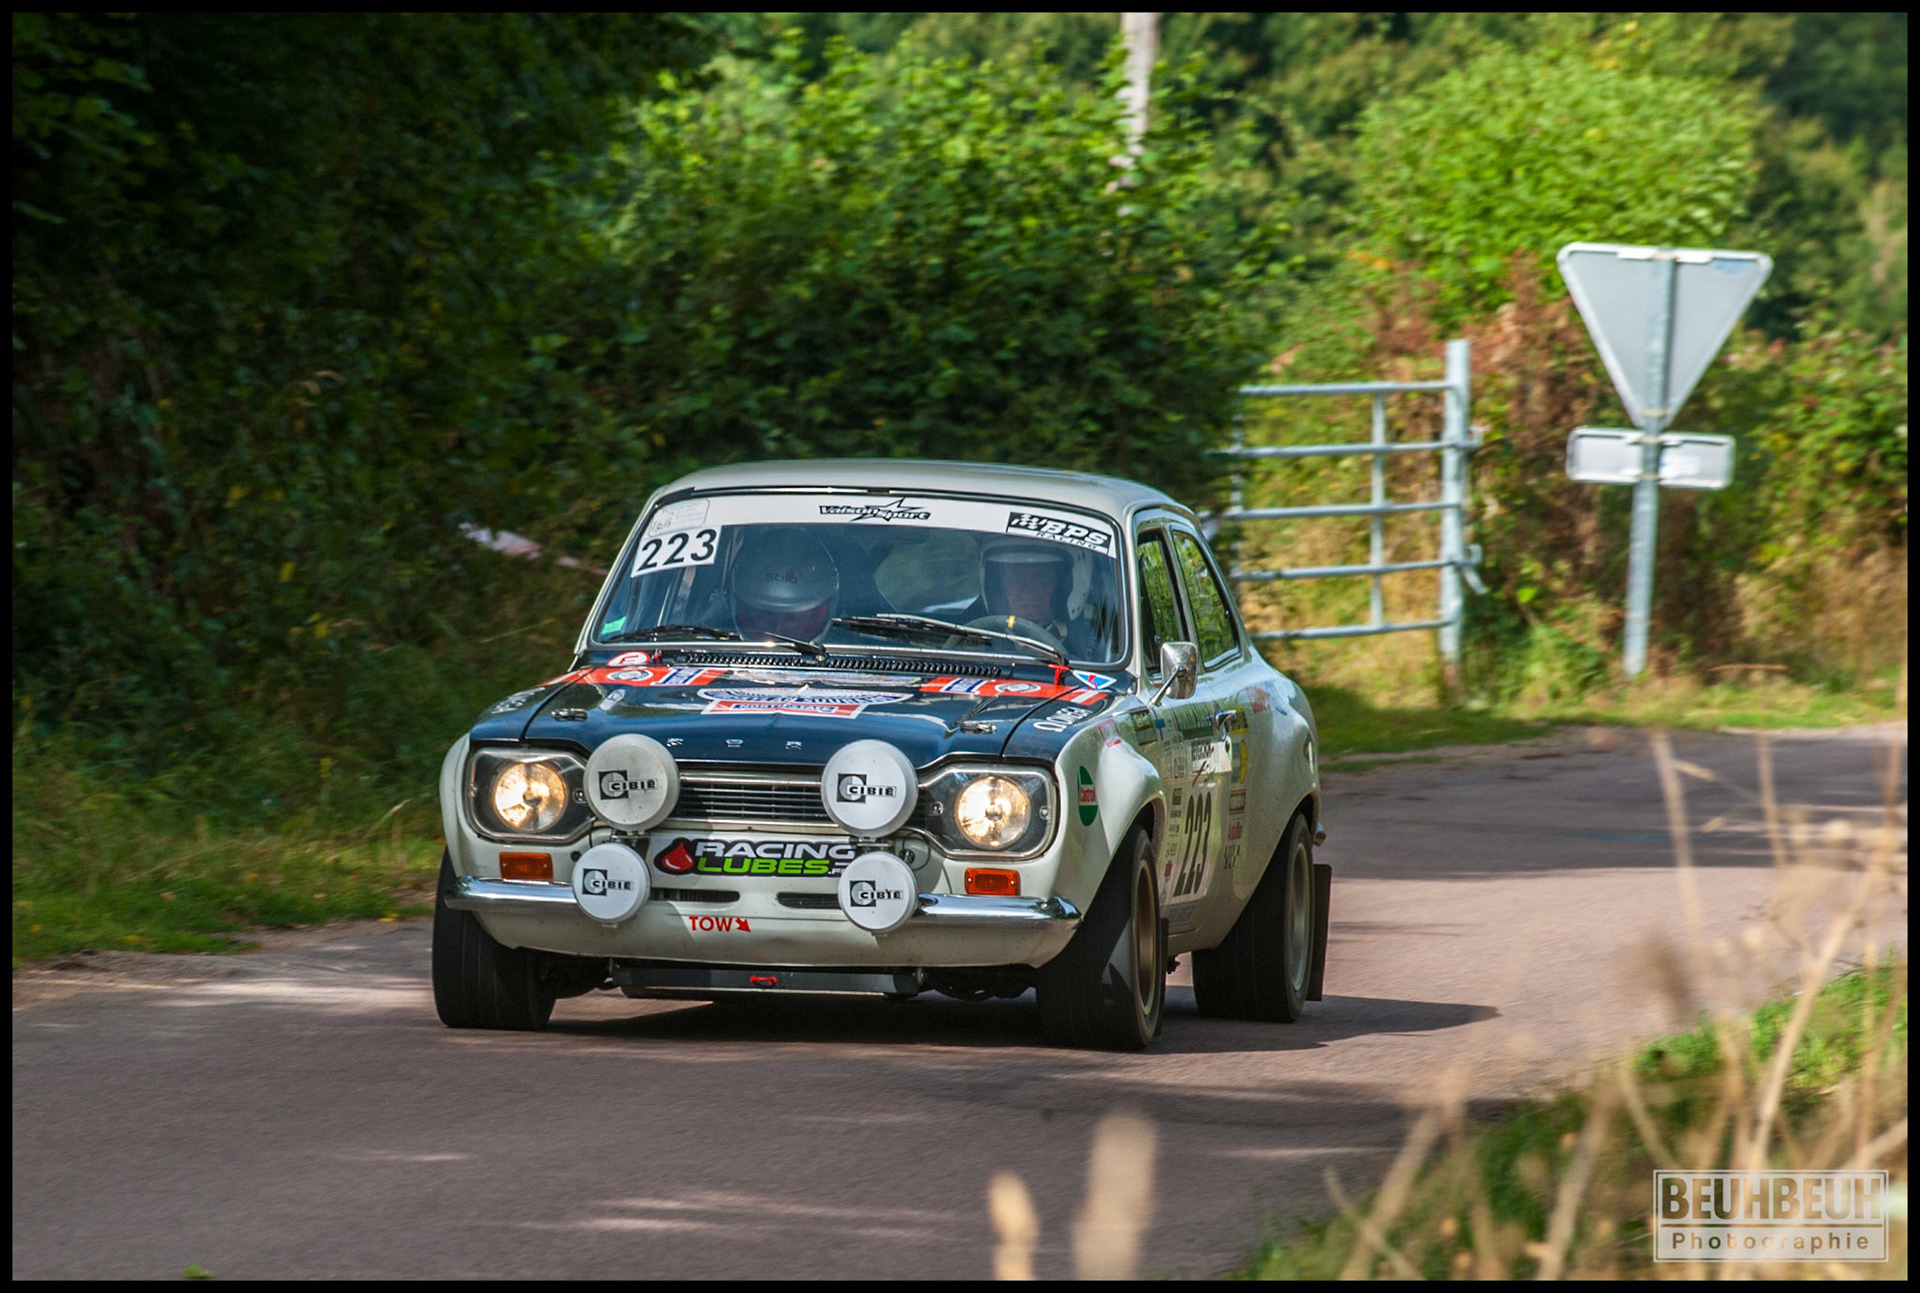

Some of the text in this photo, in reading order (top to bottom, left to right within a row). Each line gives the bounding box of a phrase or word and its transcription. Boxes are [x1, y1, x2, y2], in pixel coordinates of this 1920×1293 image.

[1036, 530, 1097, 550] RACING
[1040, 519, 1108, 545] BPS
[637, 528, 717, 572] 223
[695, 842, 855, 860] RACING
[1173, 791, 1212, 898] 223
[689, 916, 734, 932] TOW
